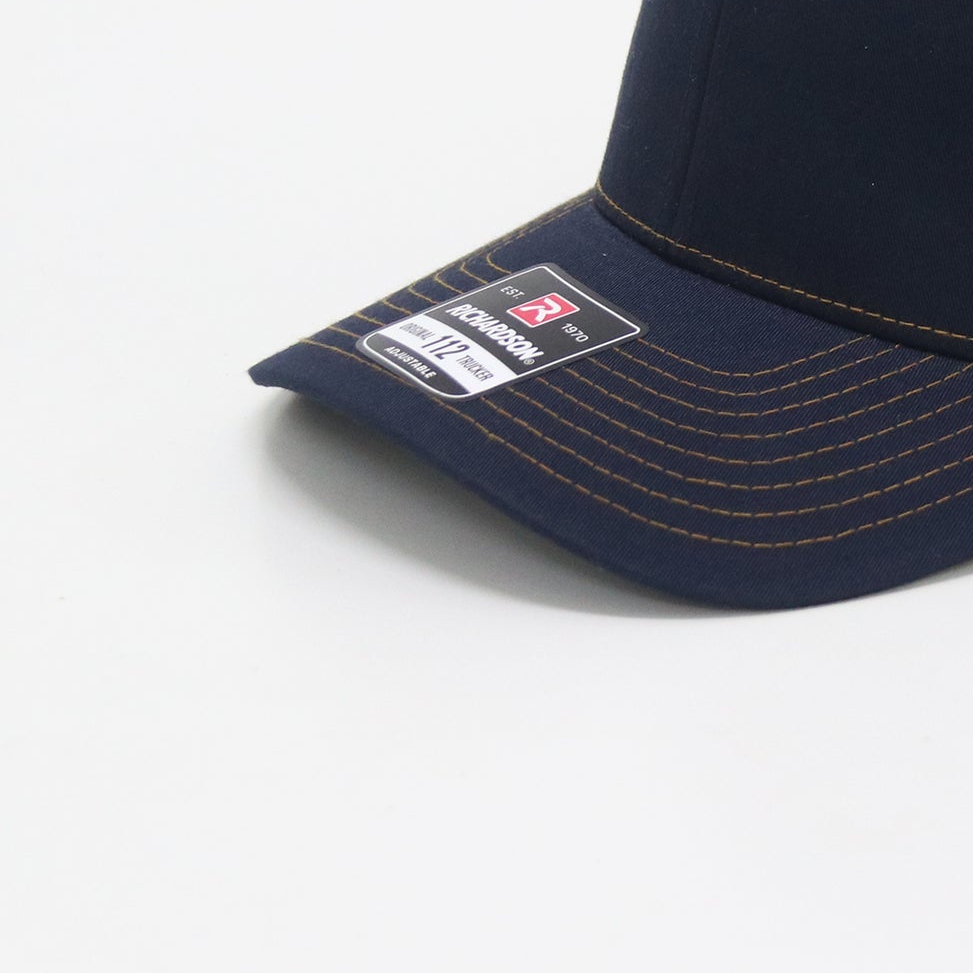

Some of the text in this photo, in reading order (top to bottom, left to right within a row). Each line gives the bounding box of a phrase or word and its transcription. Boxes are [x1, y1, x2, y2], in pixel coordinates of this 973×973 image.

[500, 285, 525, 300] EST.
[561, 322, 589, 343] 1970
[383, 346, 438, 379] ADJUSTABLE
[421, 334, 470, 360] 112
[456, 354, 494, 382] TRUCKER
